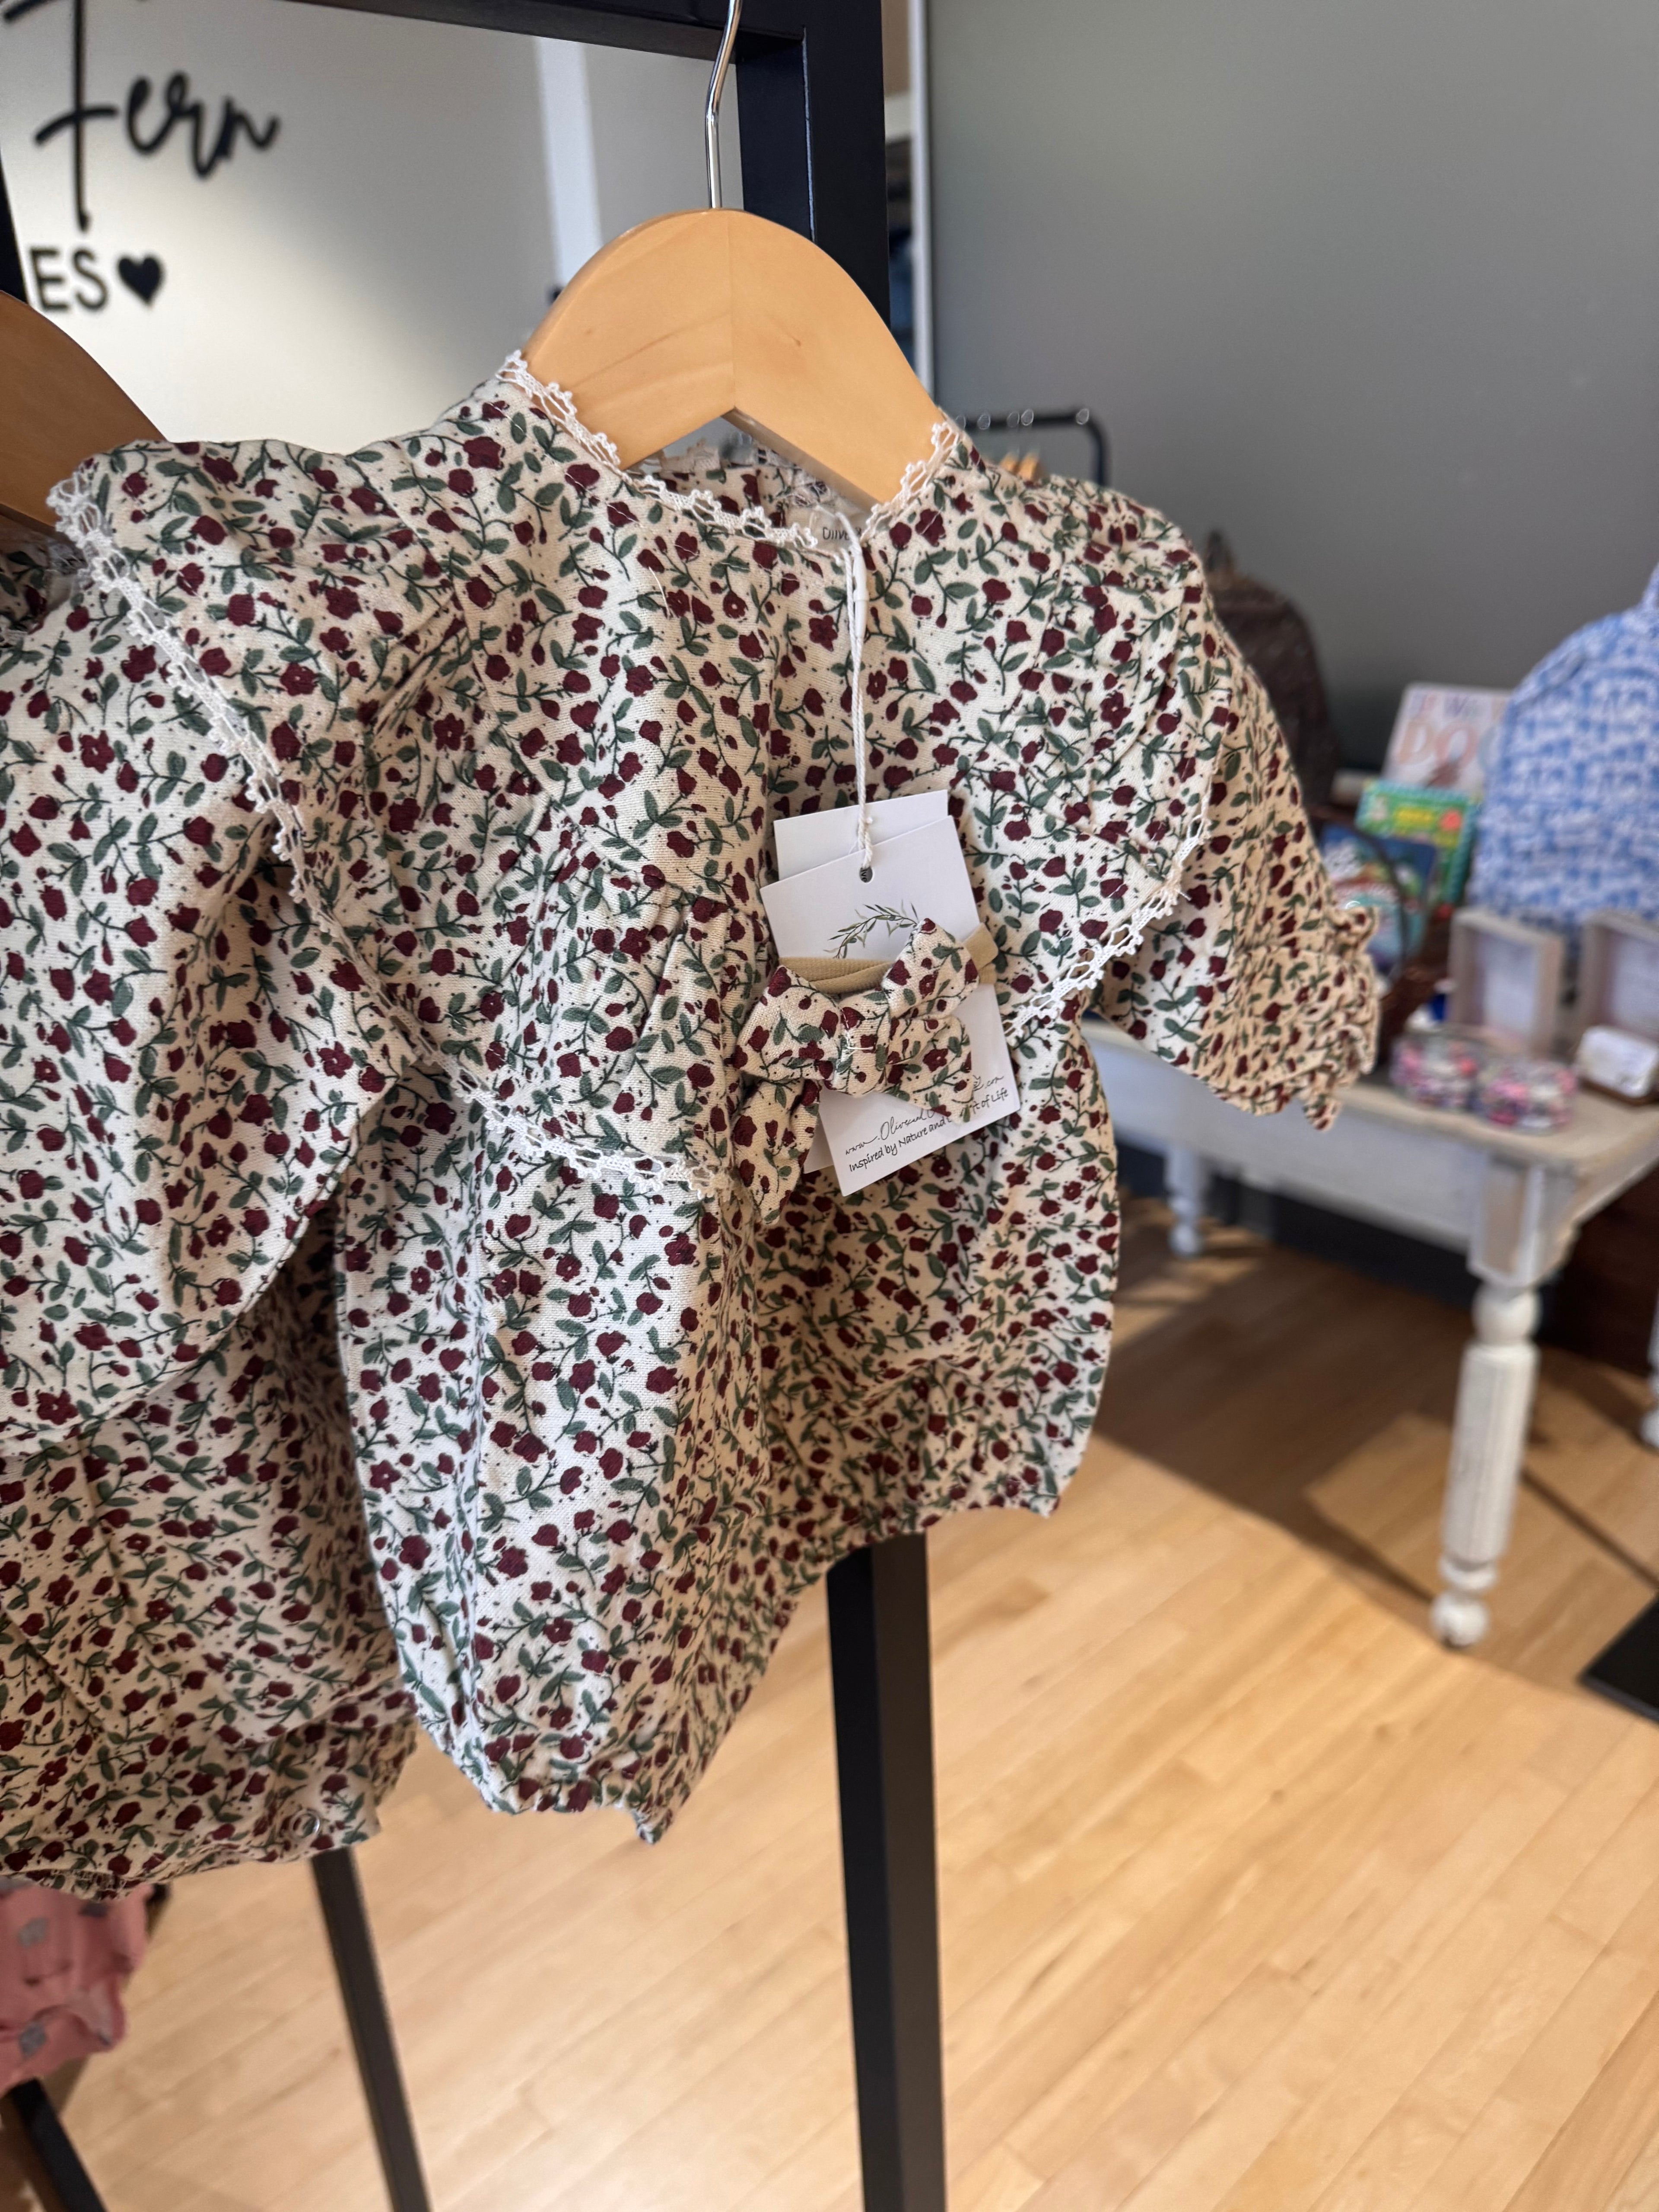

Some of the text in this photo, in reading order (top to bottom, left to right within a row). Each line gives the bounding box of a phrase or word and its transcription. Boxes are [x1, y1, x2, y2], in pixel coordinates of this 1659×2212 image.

[4, 0, 281, 233] Fern
[29, 245, 108, 312] ES
[849, 1147, 884, 1172] Inspired
[884, 1142, 898, 1156] by
[899, 1127, 928, 1147] Nature
[928, 1116, 946, 1132] and
[981, 1094, 990, 1108] of
[991, 1087, 1008, 1102] Life
